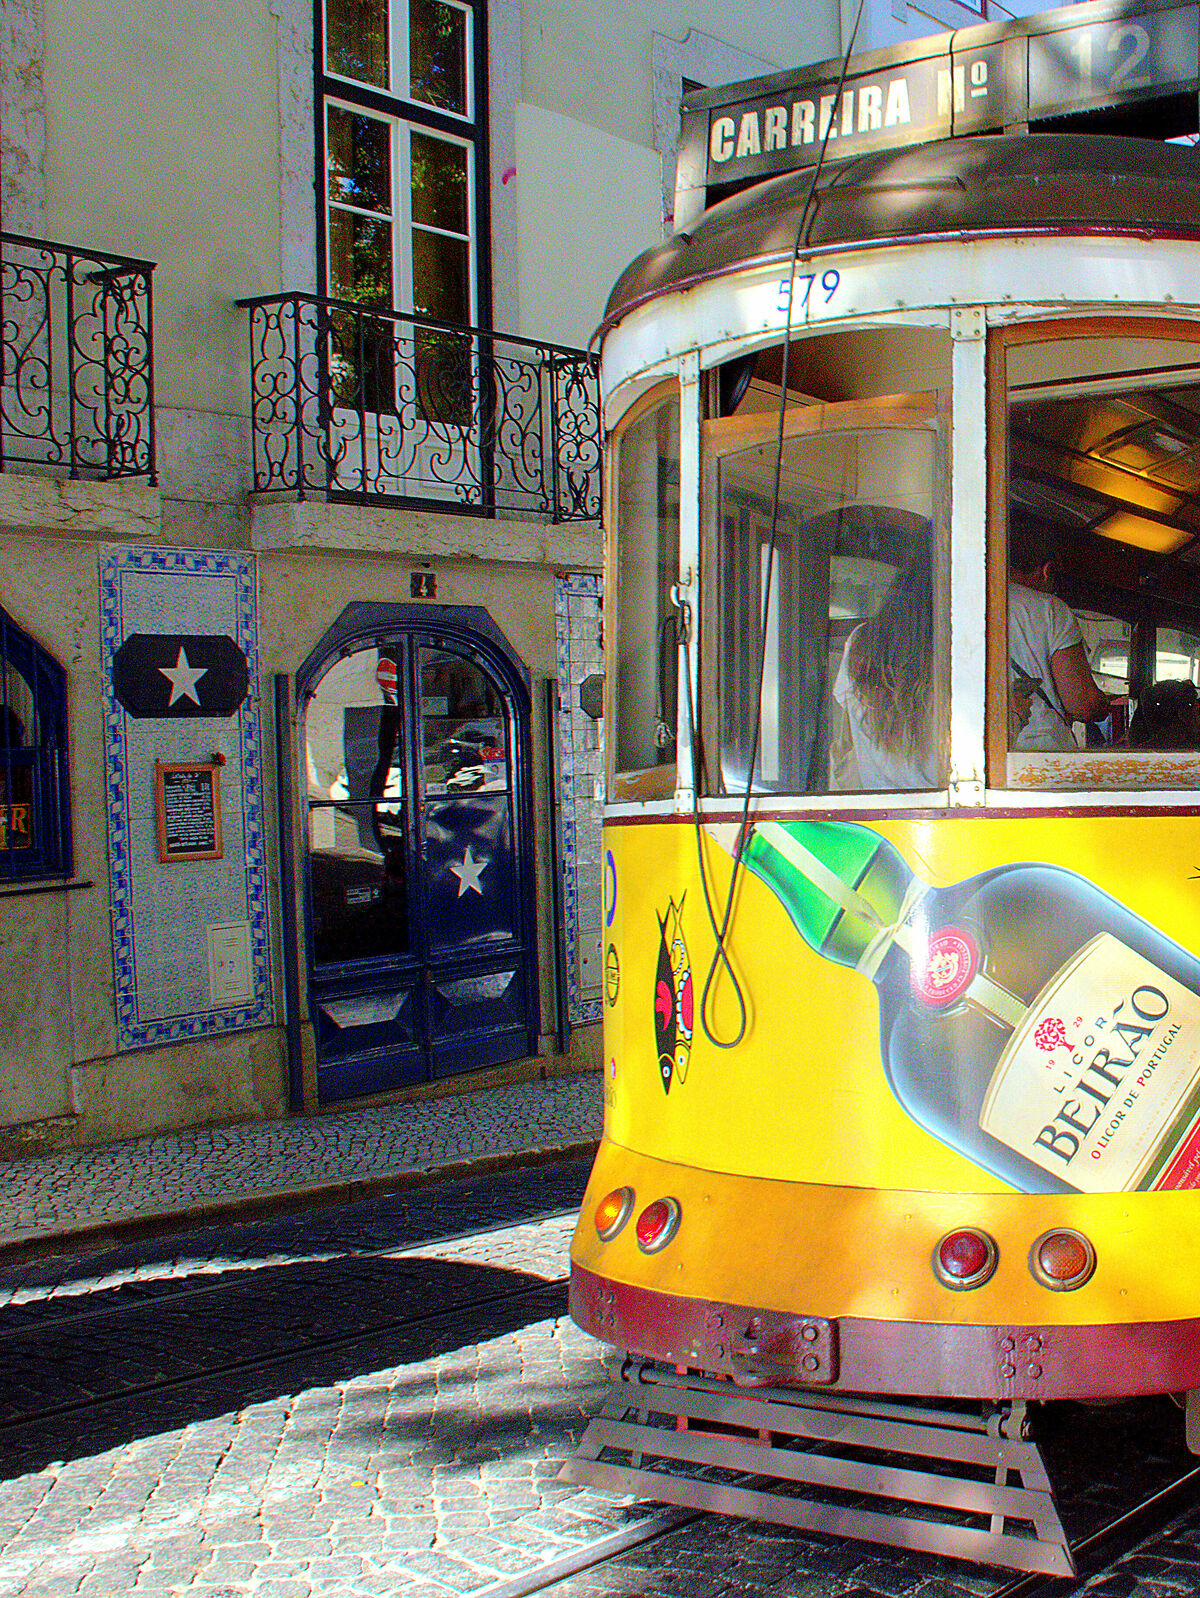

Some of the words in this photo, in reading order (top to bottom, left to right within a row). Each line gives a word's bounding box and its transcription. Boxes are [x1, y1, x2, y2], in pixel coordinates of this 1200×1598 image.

[710, 77, 911, 162] CARREIRA
[1071, 24, 1152, 90] 12
[778, 269, 840, 313] 579
[1033, 985, 1169, 1166] BEIRÃO
[1045, 1059, 1055, 1070] 19
[1073, 1016, 1083, 1028] 29
[1053, 1017, 1107, 1094] LICOR
[1091, 1150, 1102, 1160] O
[1097, 1110, 1127, 1149] LICOR
[1123, 1089, 1140, 1108] DE
[1136, 1023, 1183, 1087] PORTUGAL
